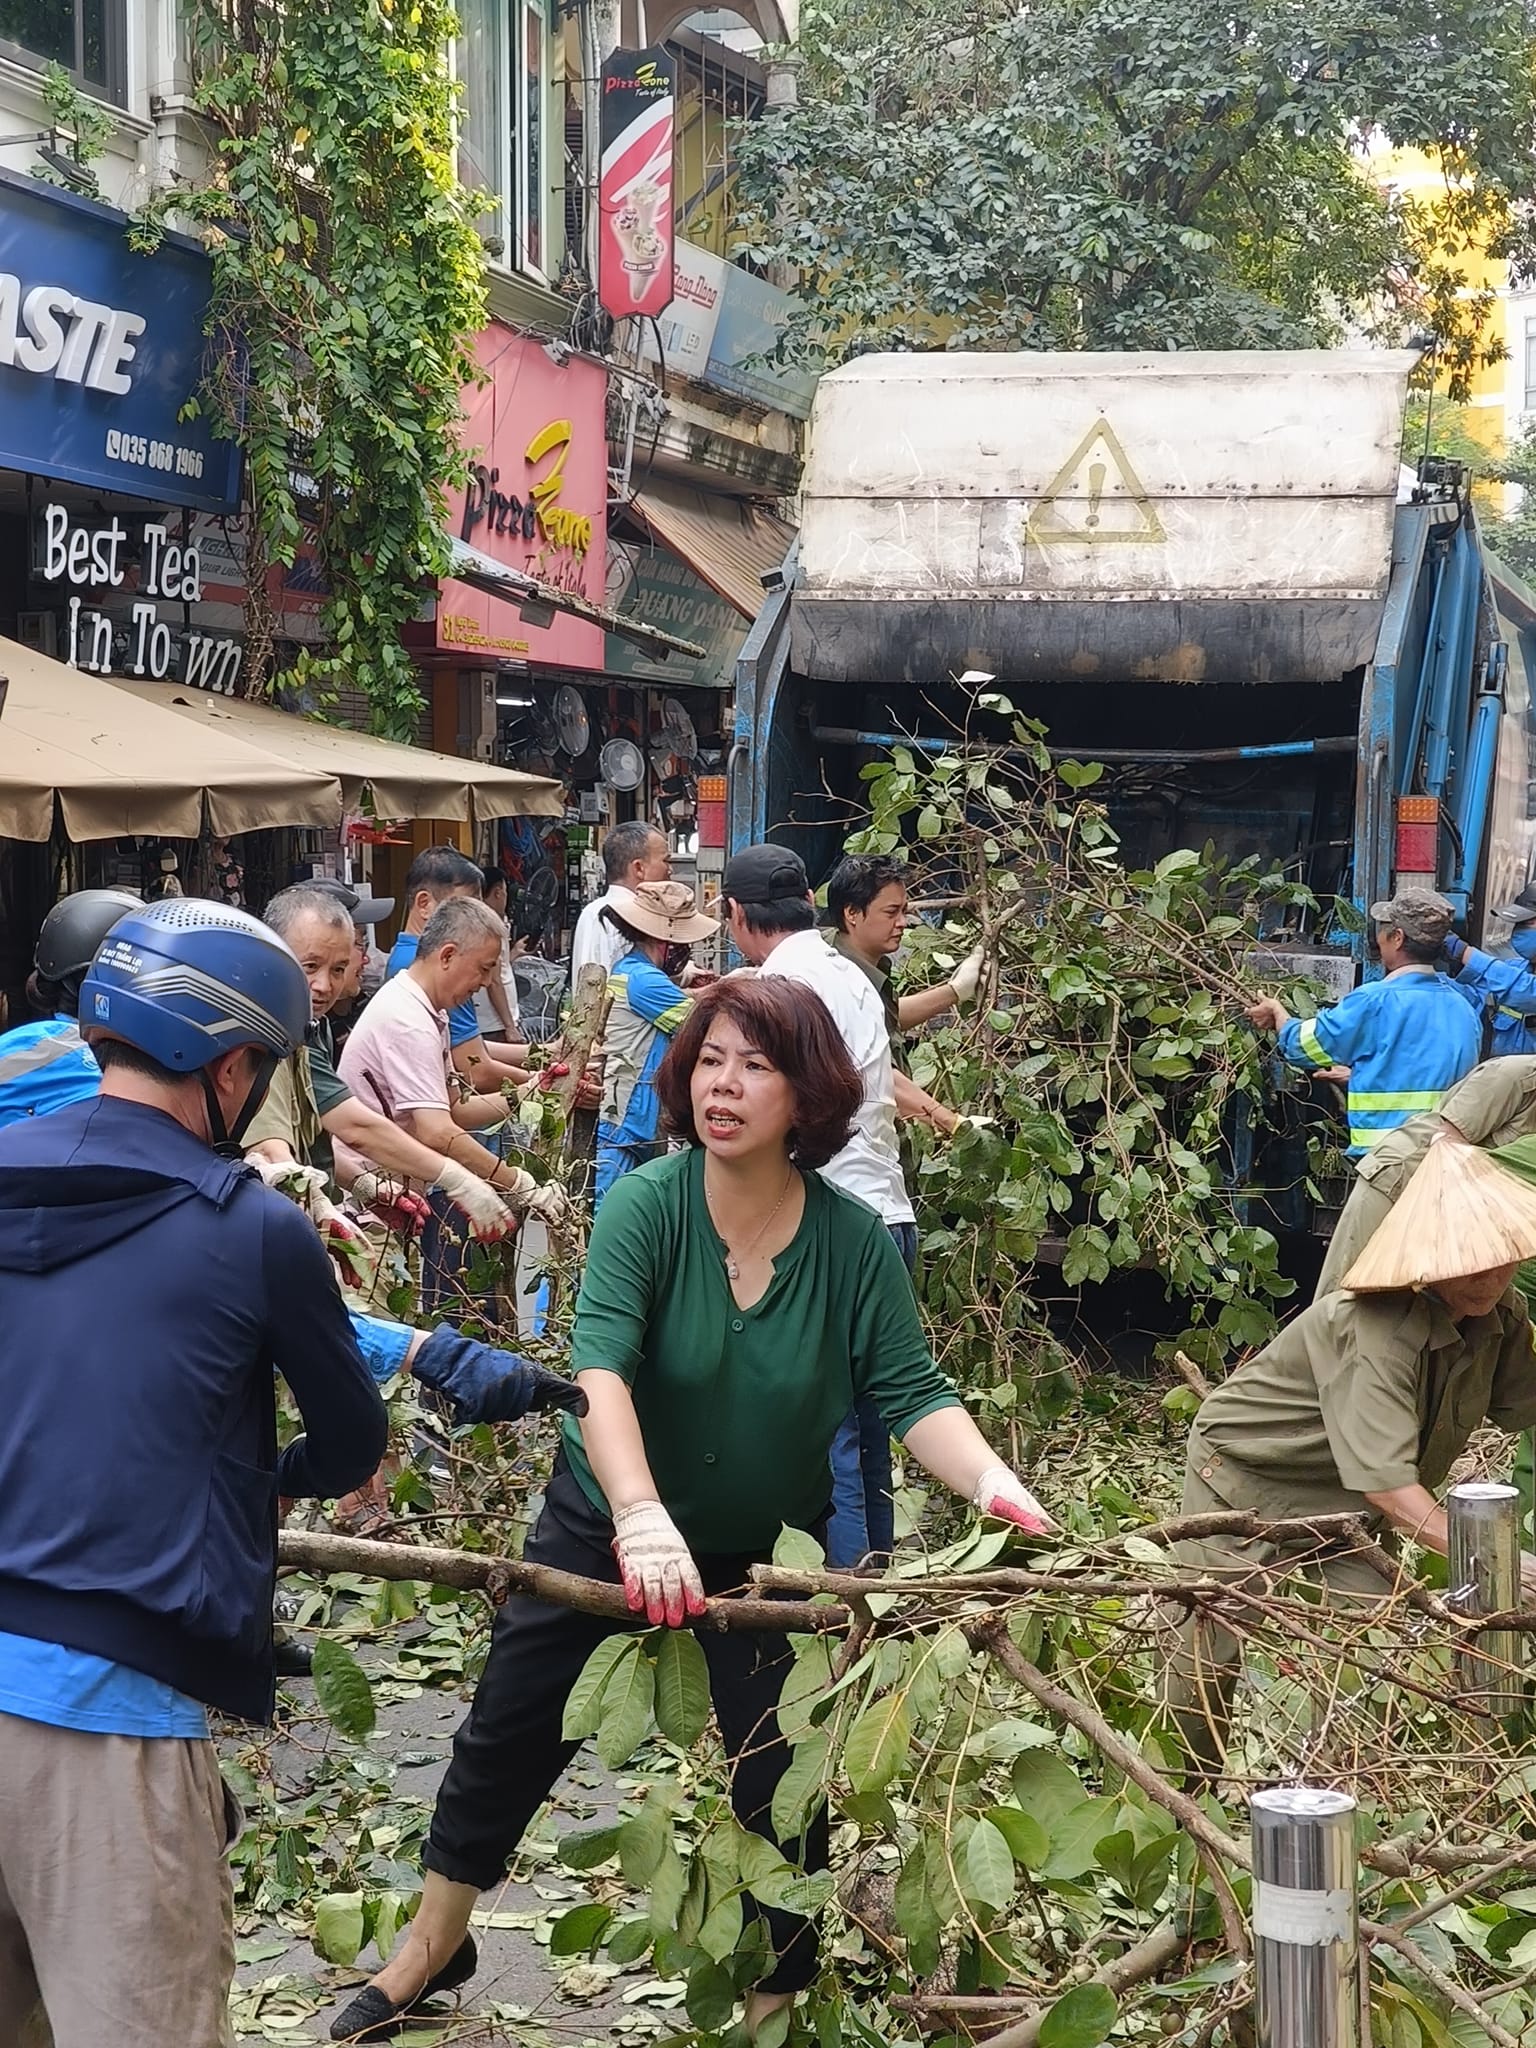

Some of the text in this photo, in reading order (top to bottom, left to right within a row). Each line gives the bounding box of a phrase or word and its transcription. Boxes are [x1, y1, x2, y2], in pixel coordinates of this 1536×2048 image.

[120, 433, 204, 479] 035 868 1966
[44, 503, 201, 602] Best Tea
[66, 595, 113, 674] In
